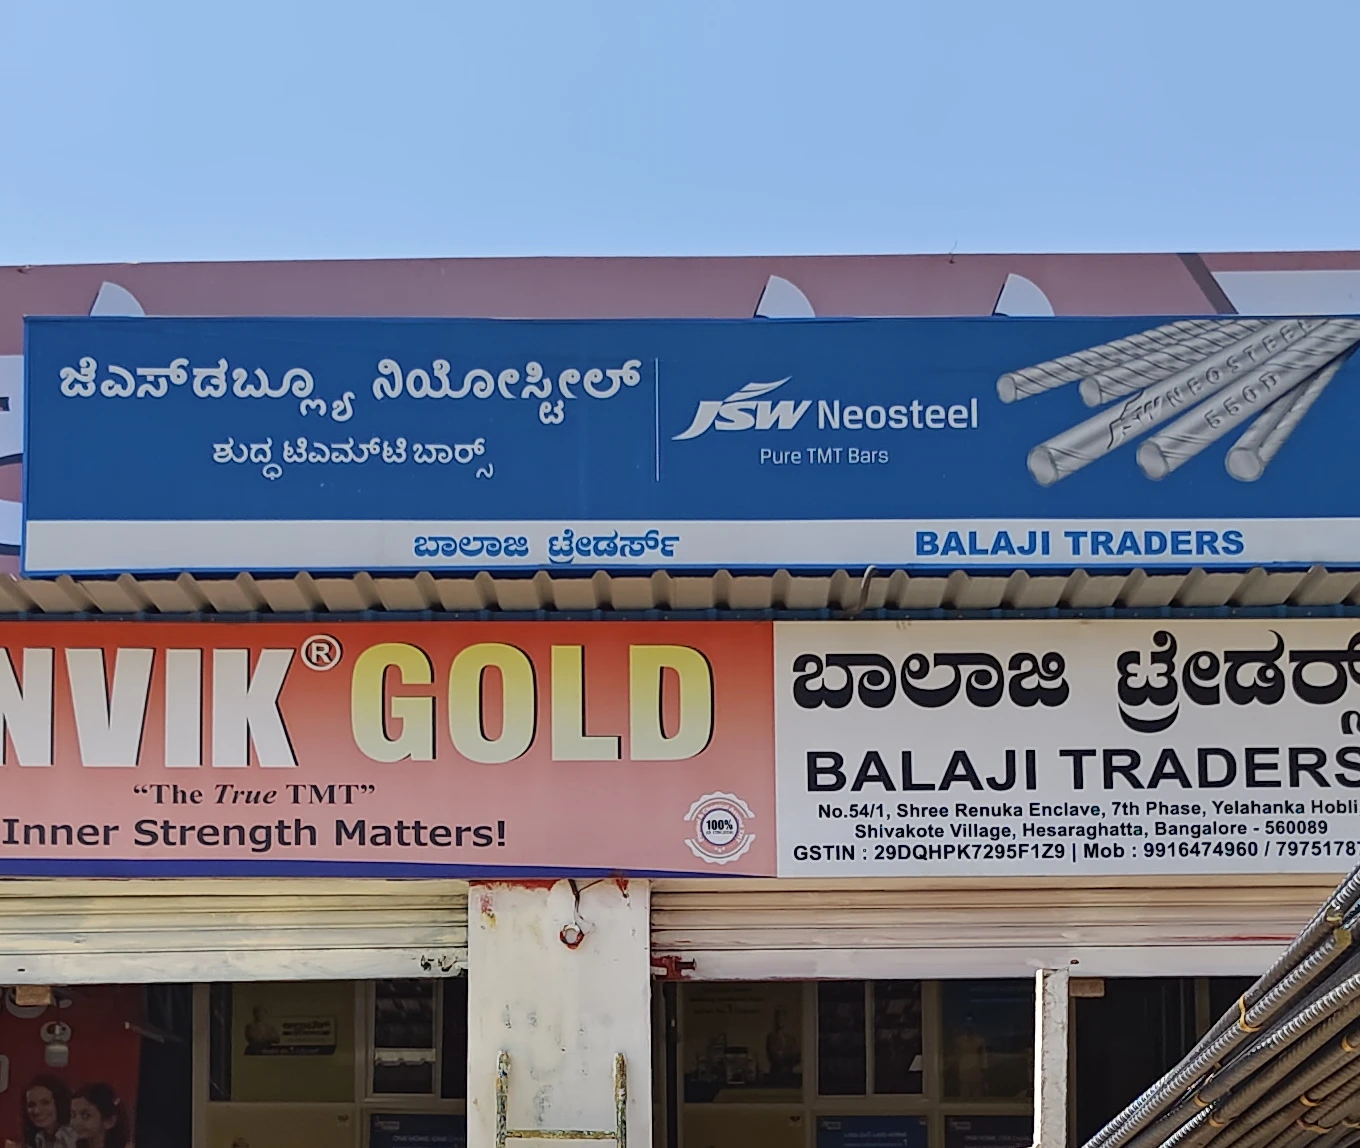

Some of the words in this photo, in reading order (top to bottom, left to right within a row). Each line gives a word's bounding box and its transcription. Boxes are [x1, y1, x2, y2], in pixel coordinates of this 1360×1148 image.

[671, 376, 814, 442] JSW
[817, 397, 978, 430] Neosteel
[759, 446, 802, 465] Pure
[806, 447, 844, 465] TMT
[848, 446, 889, 465] Bars
[915, 530, 1052, 558] BALAJI
[1063, 528, 1246, 557] TRADERS
[791, 649, 1071, 710] ಬಾಲಾಜಿ
[351, 641, 715, 763] GOLD
[805, 748, 1038, 793] BALAJI
[214, 782, 278, 806] True
[818, 804, 891, 821] No.54/1,
[896, 803, 949, 818] Shree
[955, 803, 1023, 818] Renuka
[1029, 802, 1106, 820] Enclave,
[1111, 801, 1140, 816] 7th
[1146, 801, 1207, 818] Phase,
[1212, 800, 1305, 815] Yelahanka
[1, 818, 120, 848] Inner
[132, 817, 319, 854] Strength
[334, 817, 508, 849] Matters!
[706, 819, 734, 831] 100%
[854, 824, 944, 840] Shivakote
[950, 823, 1017, 841] Village,
[1022, 822, 1149, 840] Hesaraghatta,
[1154, 821, 1248, 839] Bangalore
[1265, 820, 1328, 836] 560089
[793, 845, 855, 861] GSTIN
[874, 843, 1065, 860] 29DQHPK7295F1Z9
[1083, 843, 1125, 859] Mob
[1143, 841, 1259, 858] 9916474960
